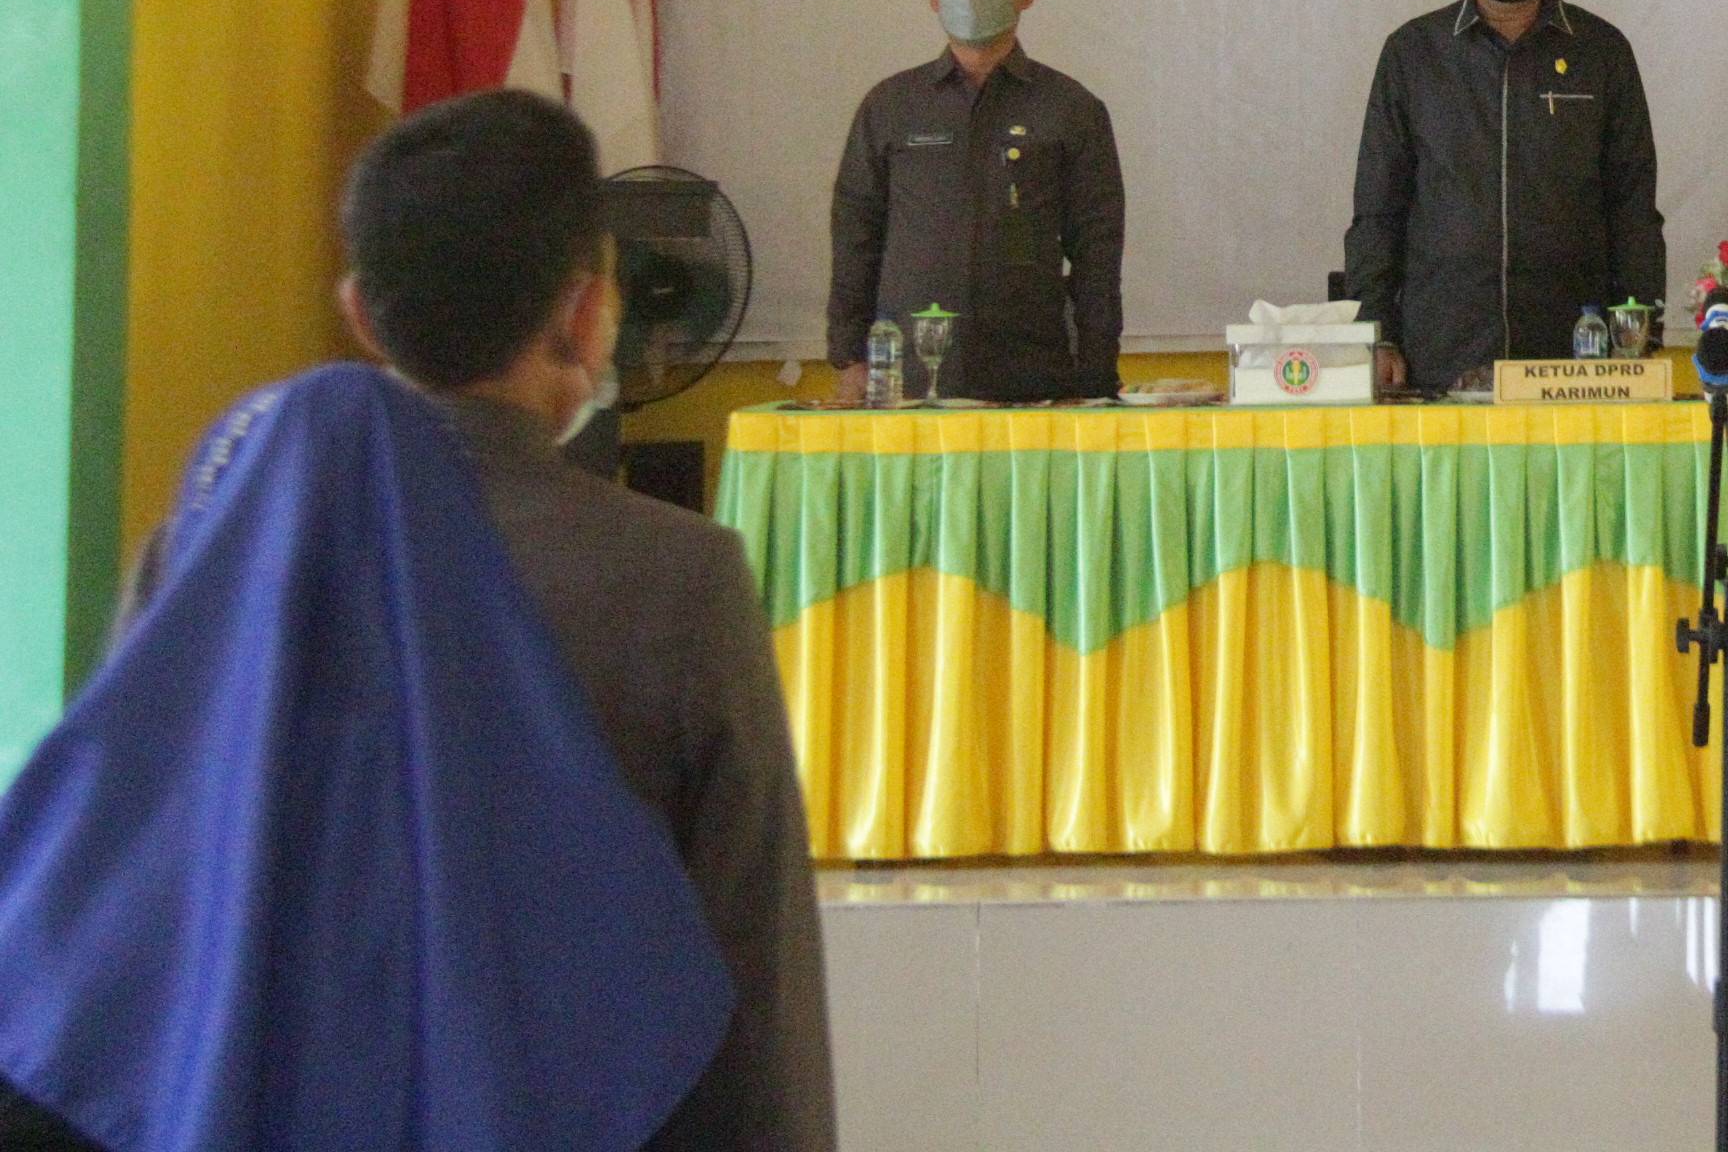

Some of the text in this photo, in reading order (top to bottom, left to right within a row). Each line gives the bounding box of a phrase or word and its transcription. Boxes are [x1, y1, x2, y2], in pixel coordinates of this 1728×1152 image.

[1524, 363, 1645, 378] KETUA DPRD
[1541, 385, 1631, 400] KARIMUN
